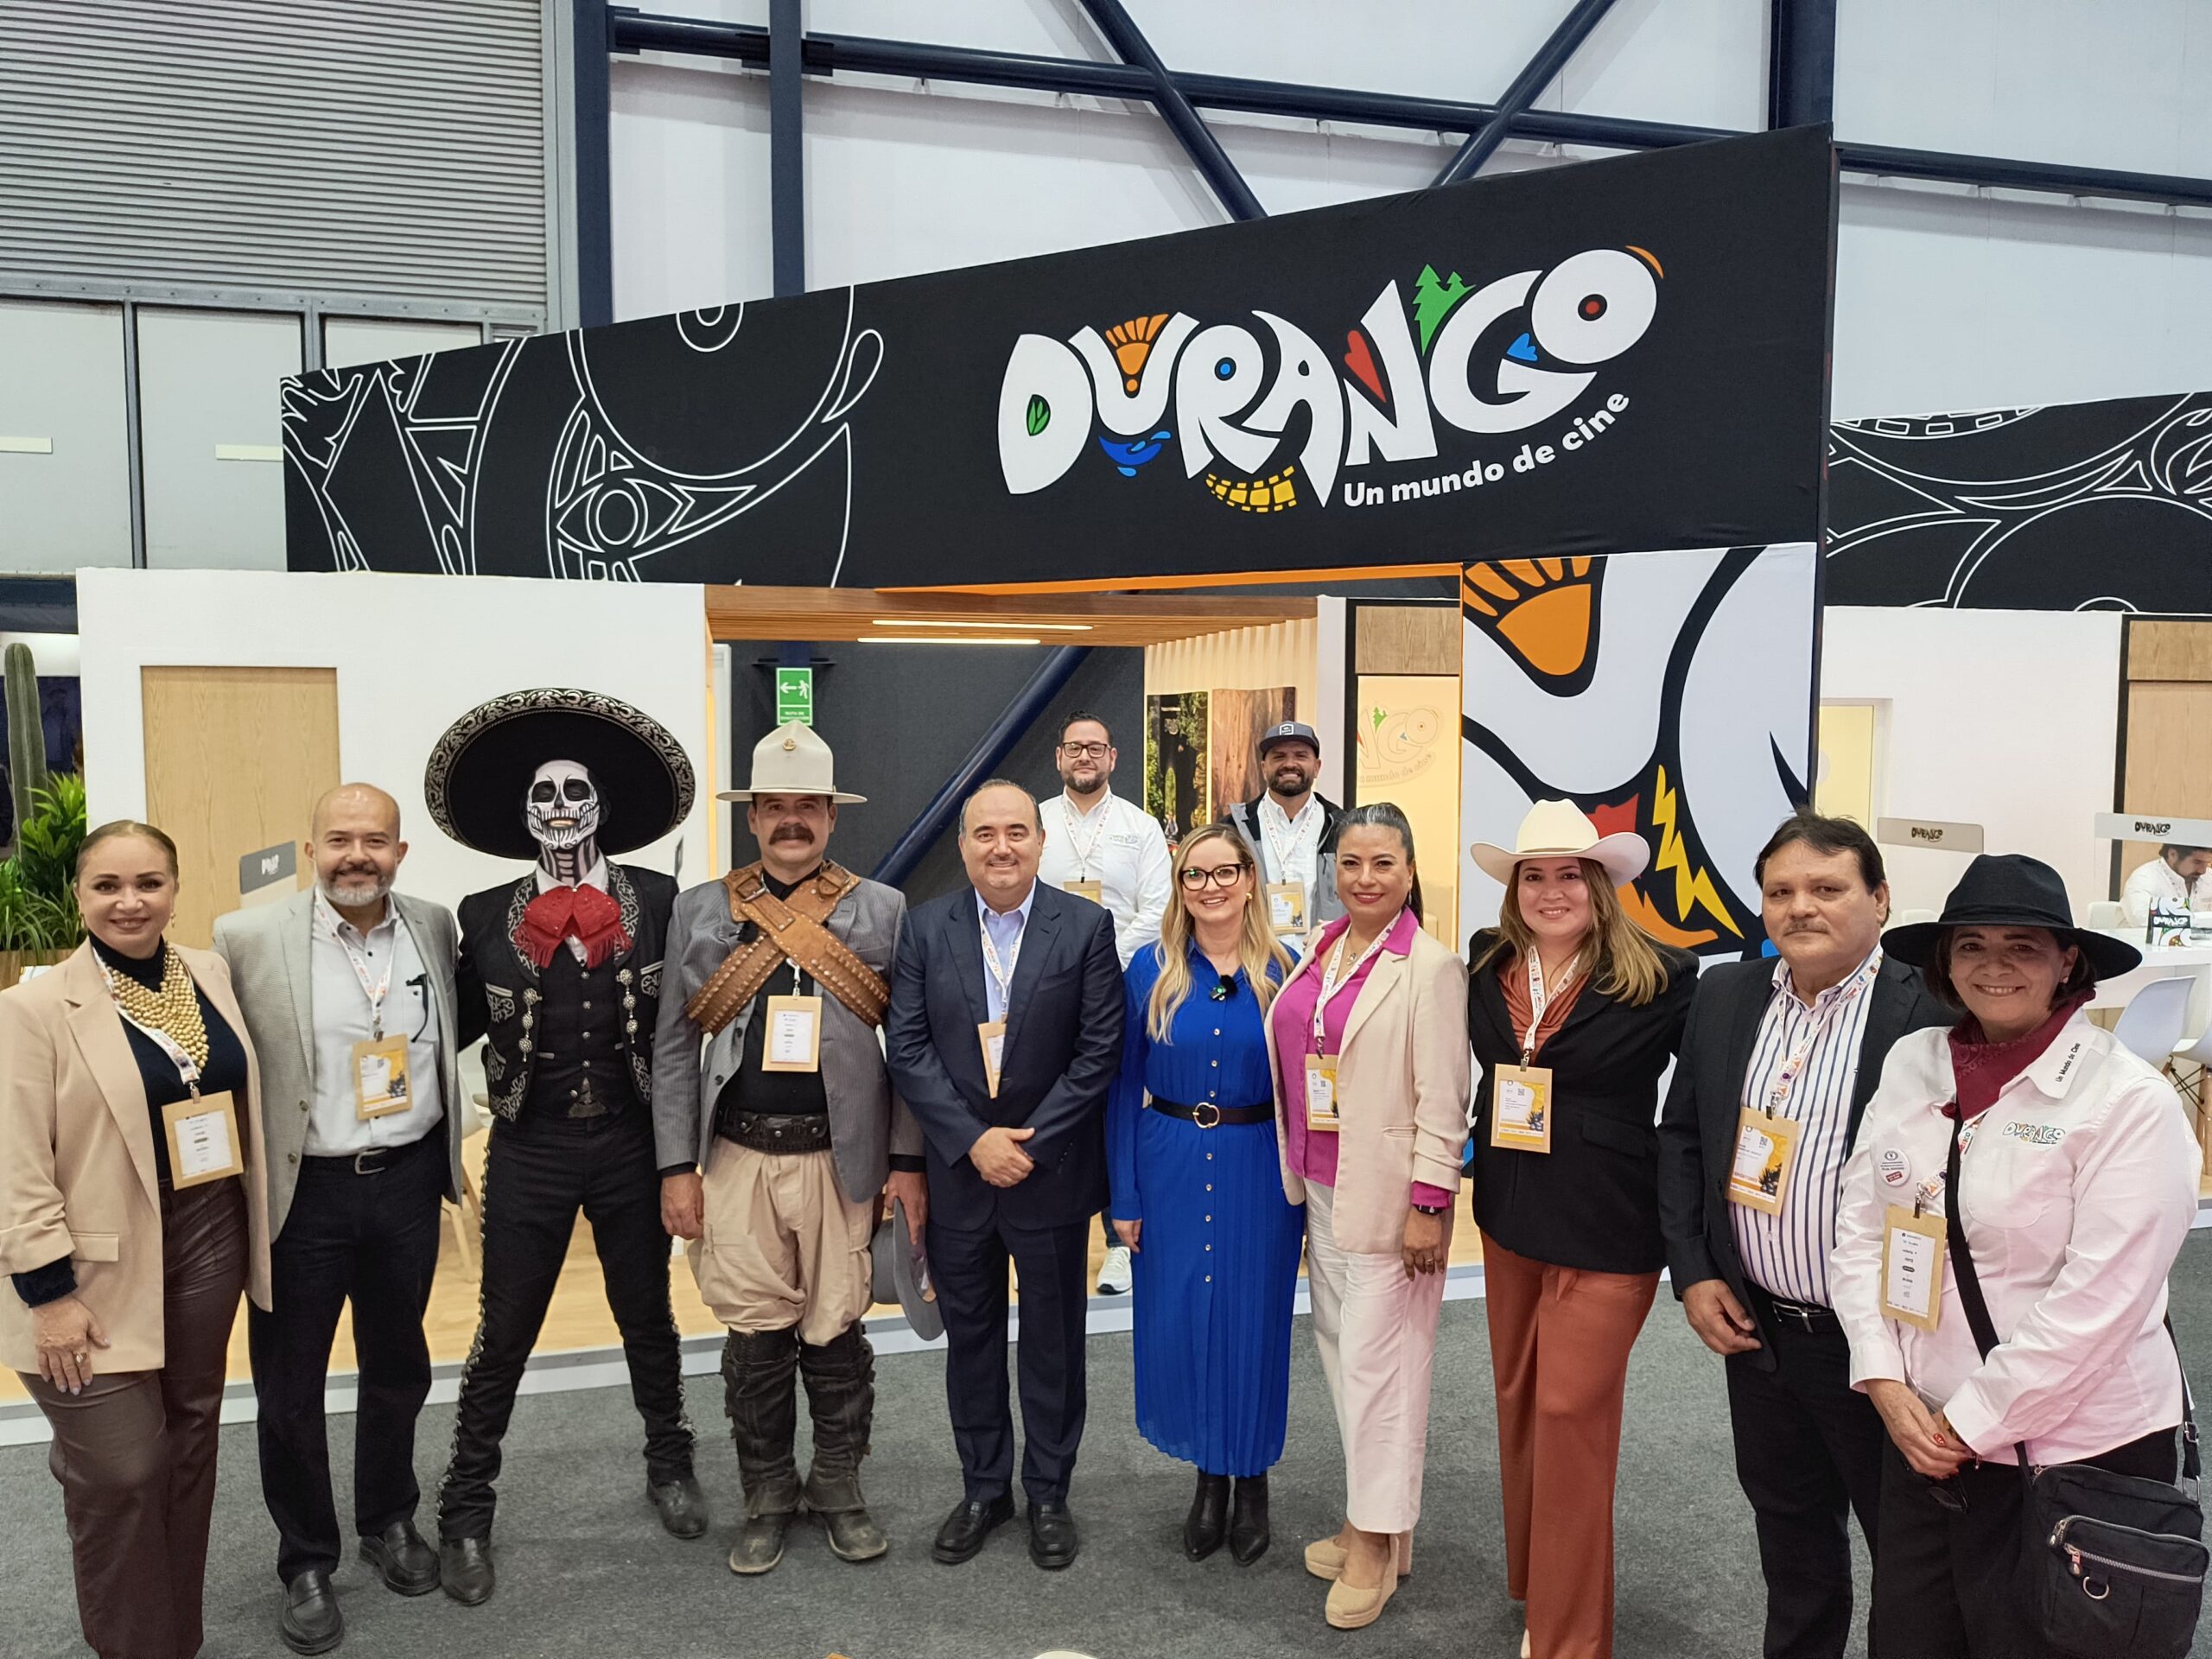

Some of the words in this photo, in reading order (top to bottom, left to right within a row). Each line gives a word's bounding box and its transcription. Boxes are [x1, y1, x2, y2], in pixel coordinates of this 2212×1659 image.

[998, 249, 1657, 507] DURANGO
[1344, 482, 1384, 507] Un
[1392, 460, 1504, 503] mundo
[1512, 443, 1555, 474] de
[1561, 392, 1629, 451] cine
[2002, 1122, 2066, 1141] DURANGO
